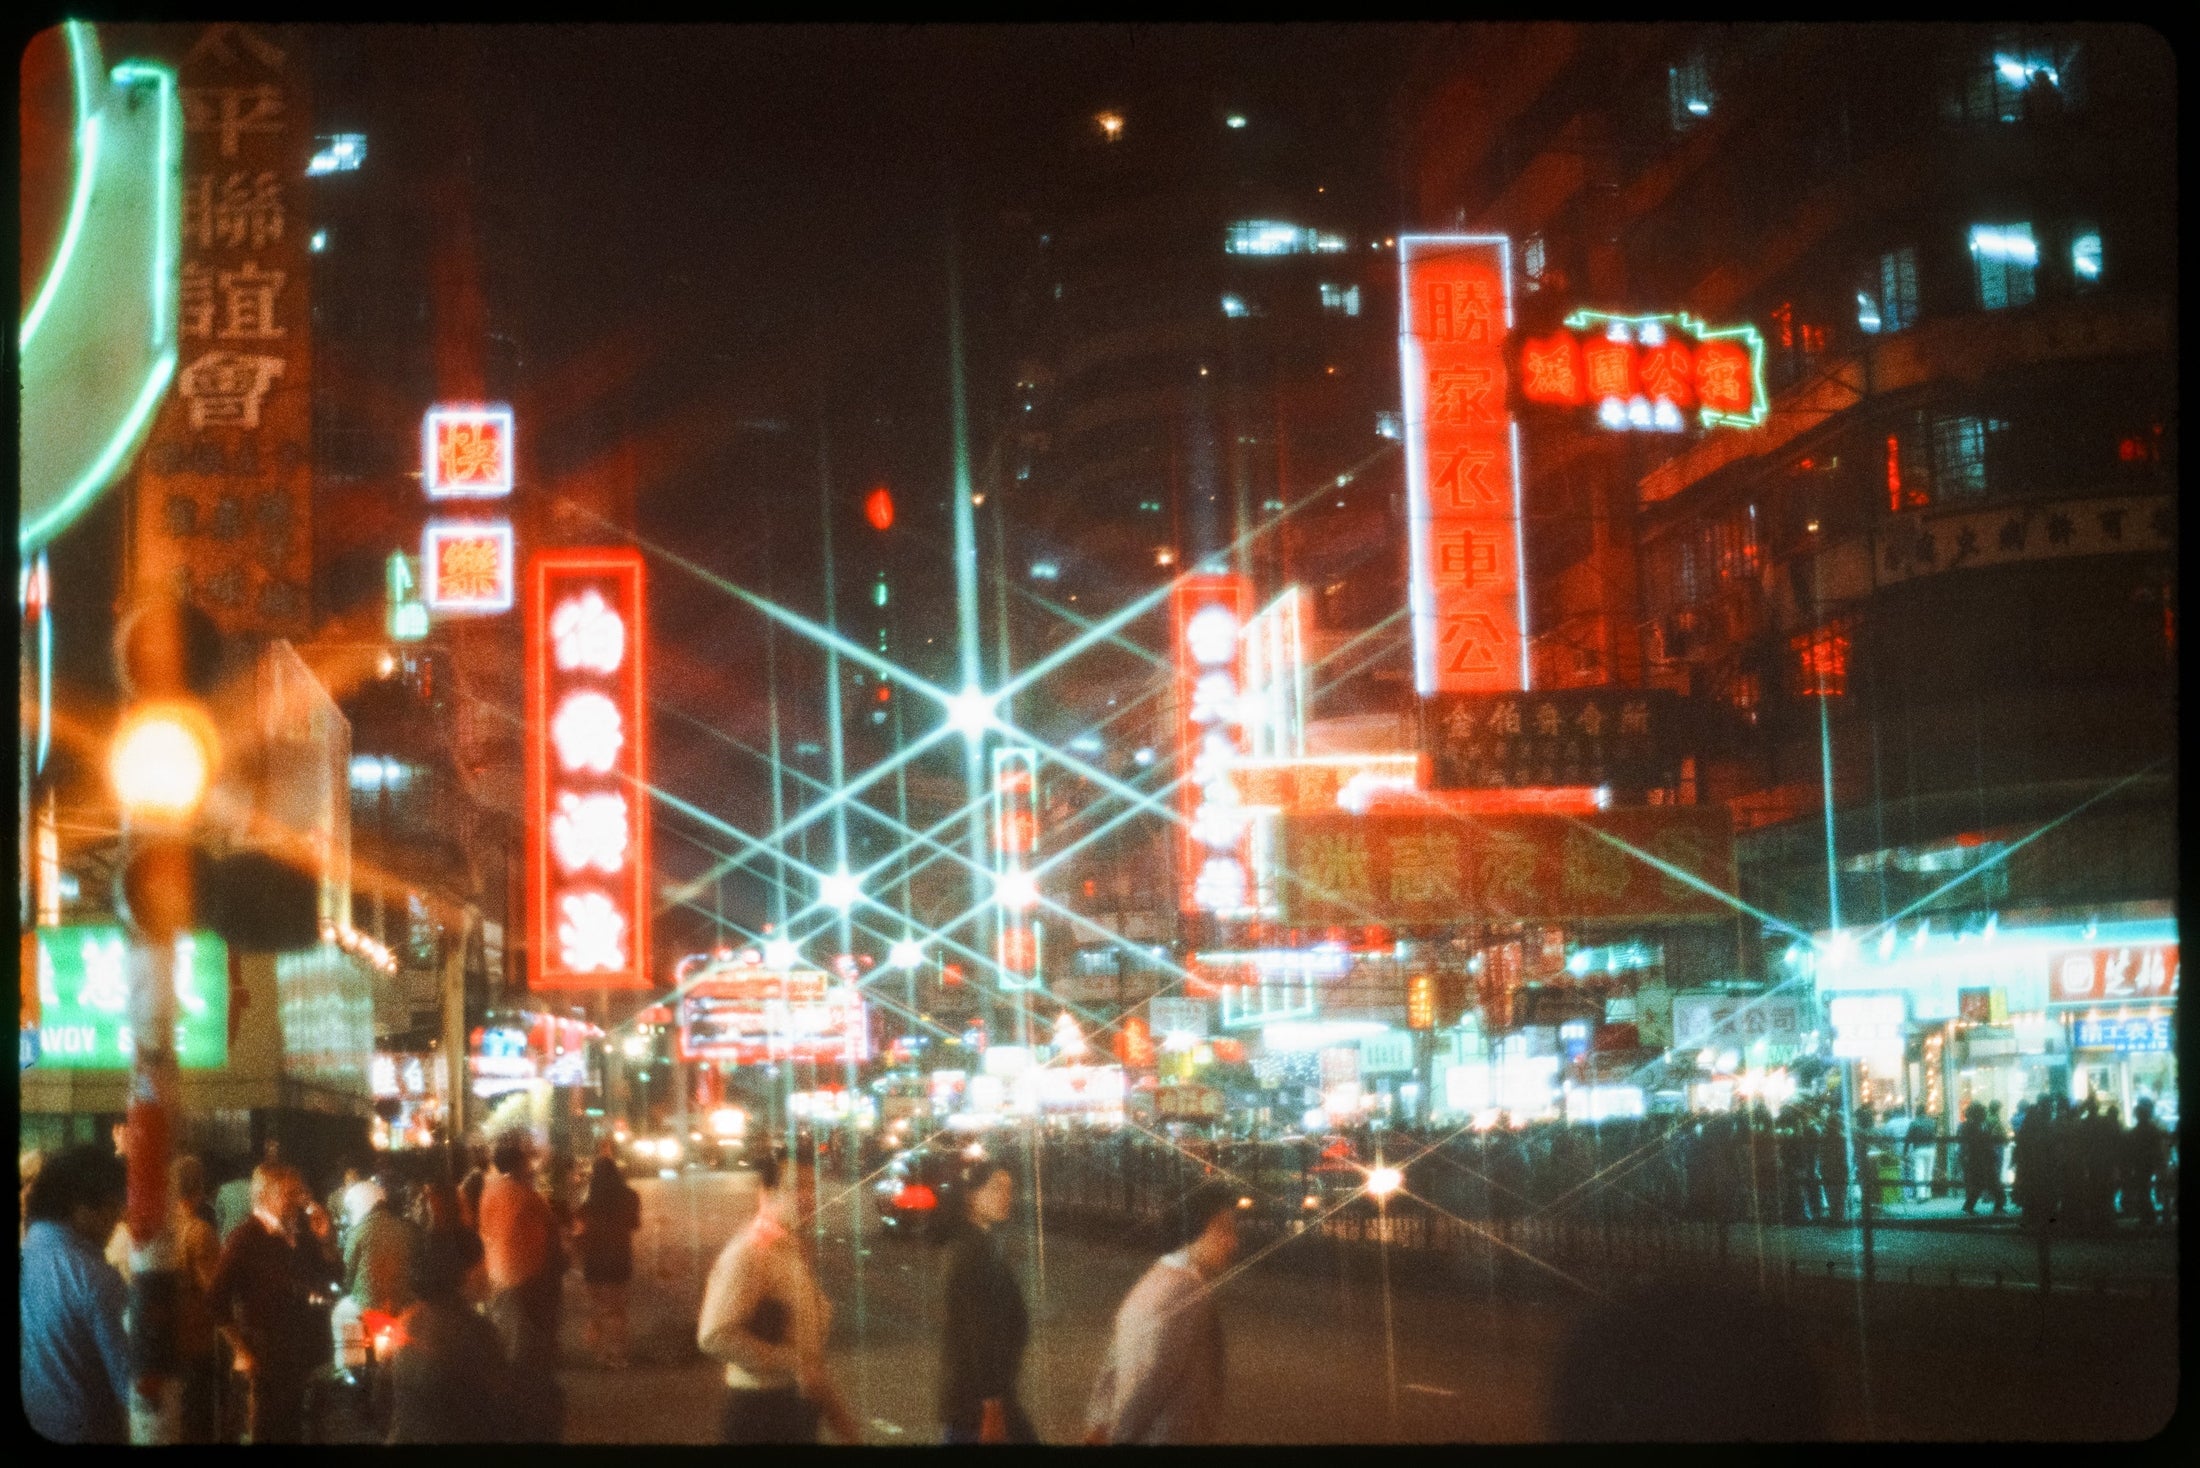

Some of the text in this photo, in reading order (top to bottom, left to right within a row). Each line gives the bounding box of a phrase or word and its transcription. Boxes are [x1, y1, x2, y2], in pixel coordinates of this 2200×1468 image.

[1424, 279, 1505, 675] 勝家衣車公
